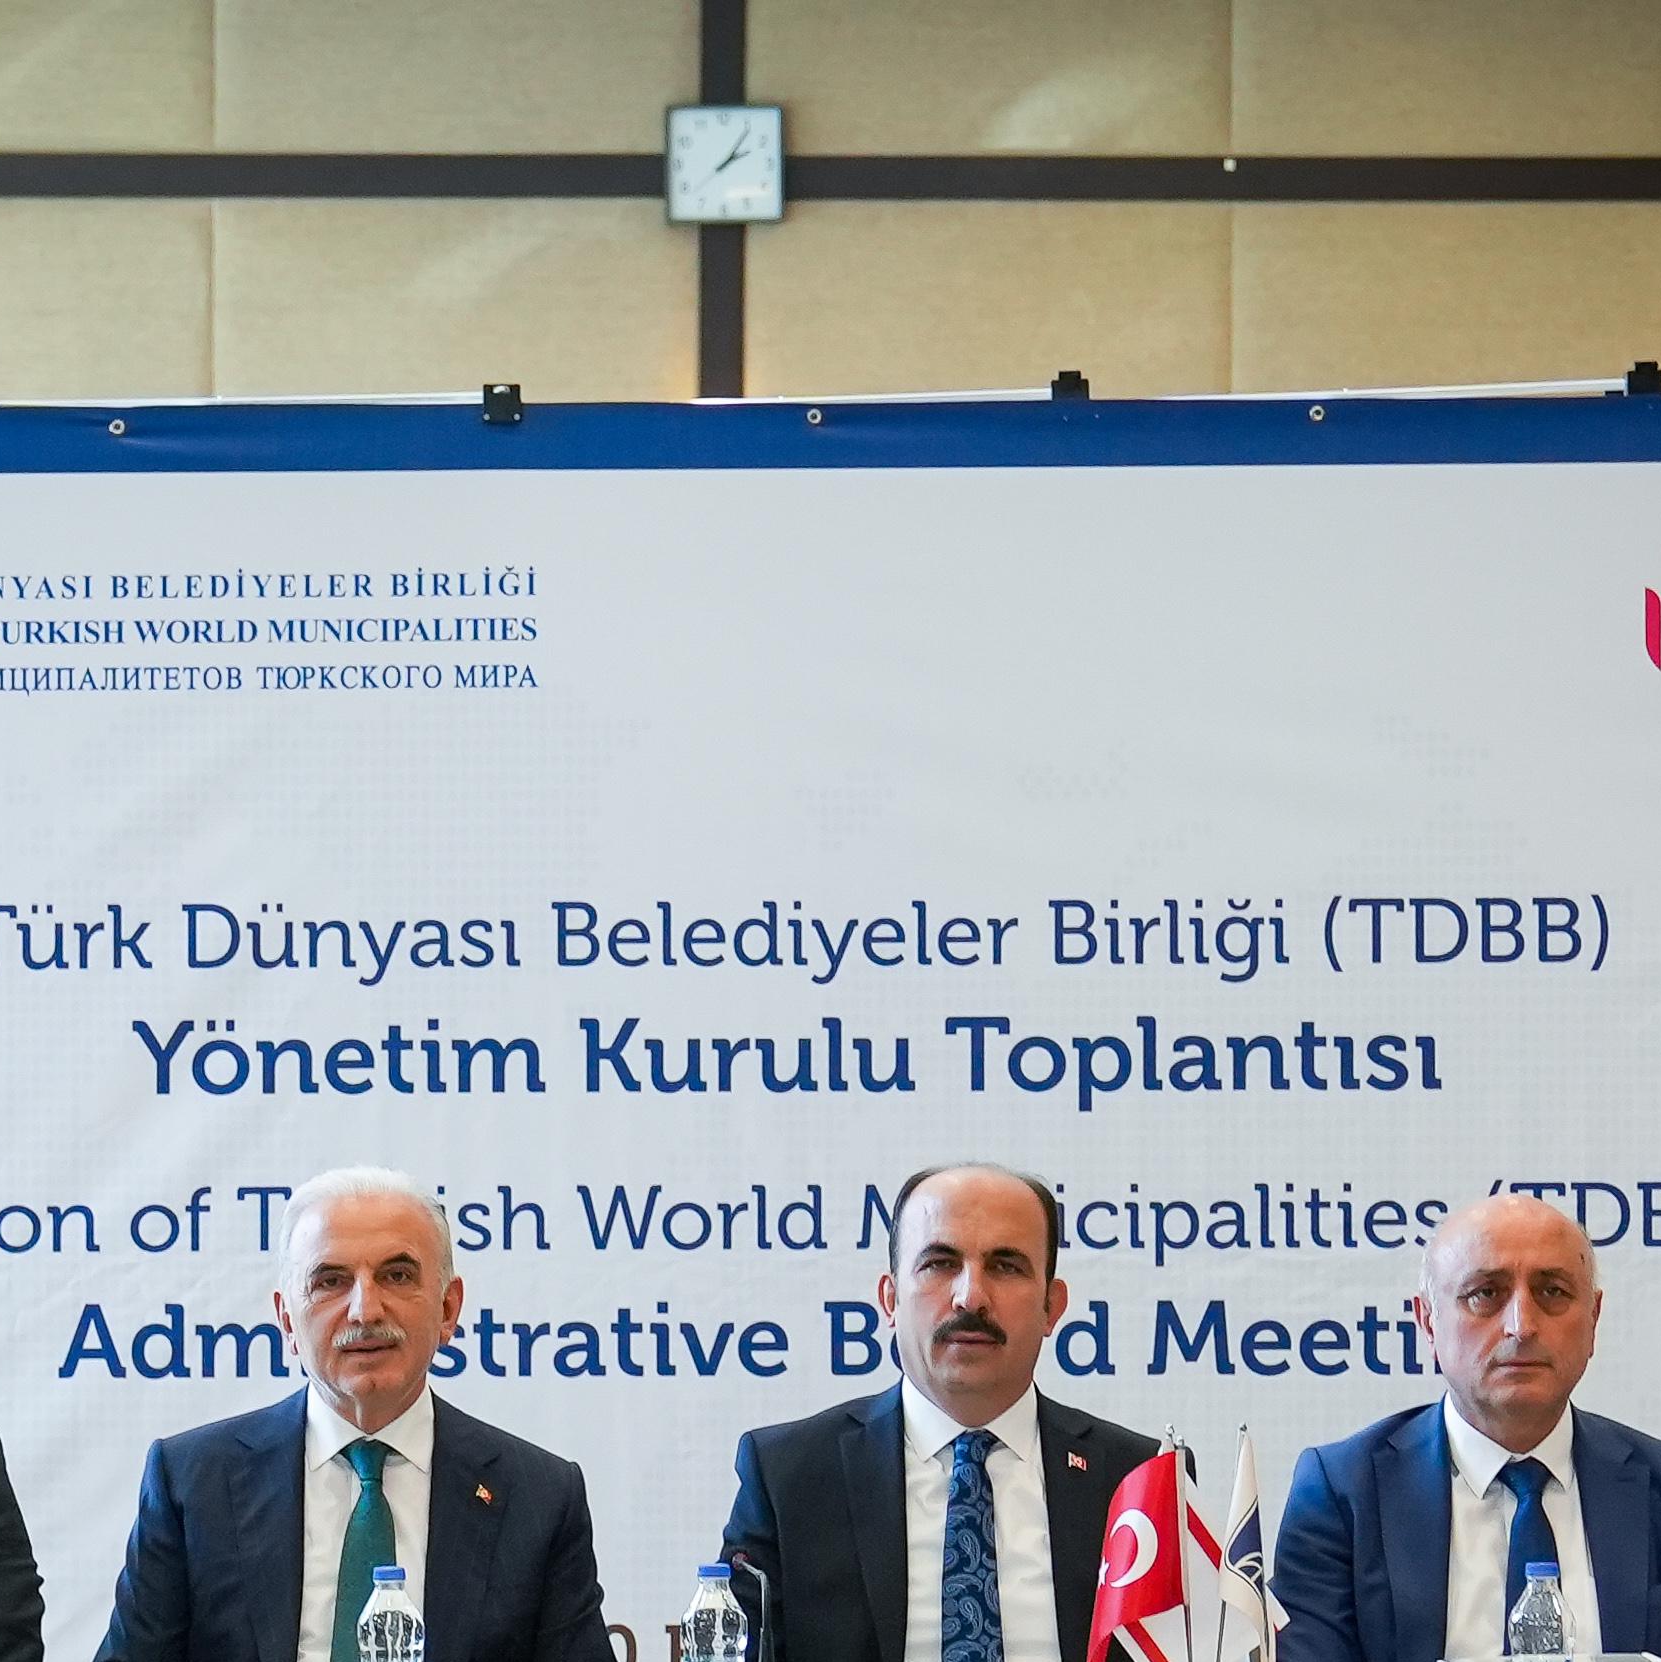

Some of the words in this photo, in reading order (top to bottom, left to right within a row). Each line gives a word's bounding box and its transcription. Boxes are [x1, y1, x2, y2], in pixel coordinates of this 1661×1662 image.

[112, 569, 372, 598] BELEDİYELER
[392, 566, 535, 596] BİRLİĞİ
[135, 620, 257, 643] WORLD
[269, 618, 536, 642] MUNICIPALITIES
[257, 665, 441, 689] ТЮРКСКОГО
[455, 665, 538, 688] МИРА
[182, 904, 520, 986] Dünyası
[552, 901, 1018, 984] Belediyeler
[1049, 899, 1289, 983] Birliği
[1325, 895, 1610, 972] (TDBB)
[132, 1019, 545, 1094] Yönetim
[580, 1017, 915, 1093] Kurulu
[945, 1016, 1442, 1112] Toplantısı
[131, 1187, 211, 1252] of
[577, 1185, 827, 1250] World
[857, 1183, 1448, 1266] icipalities
[59, 1302, 788, 1378] Admstrative
[1150, 1298, 1442, 1376] Meeti
